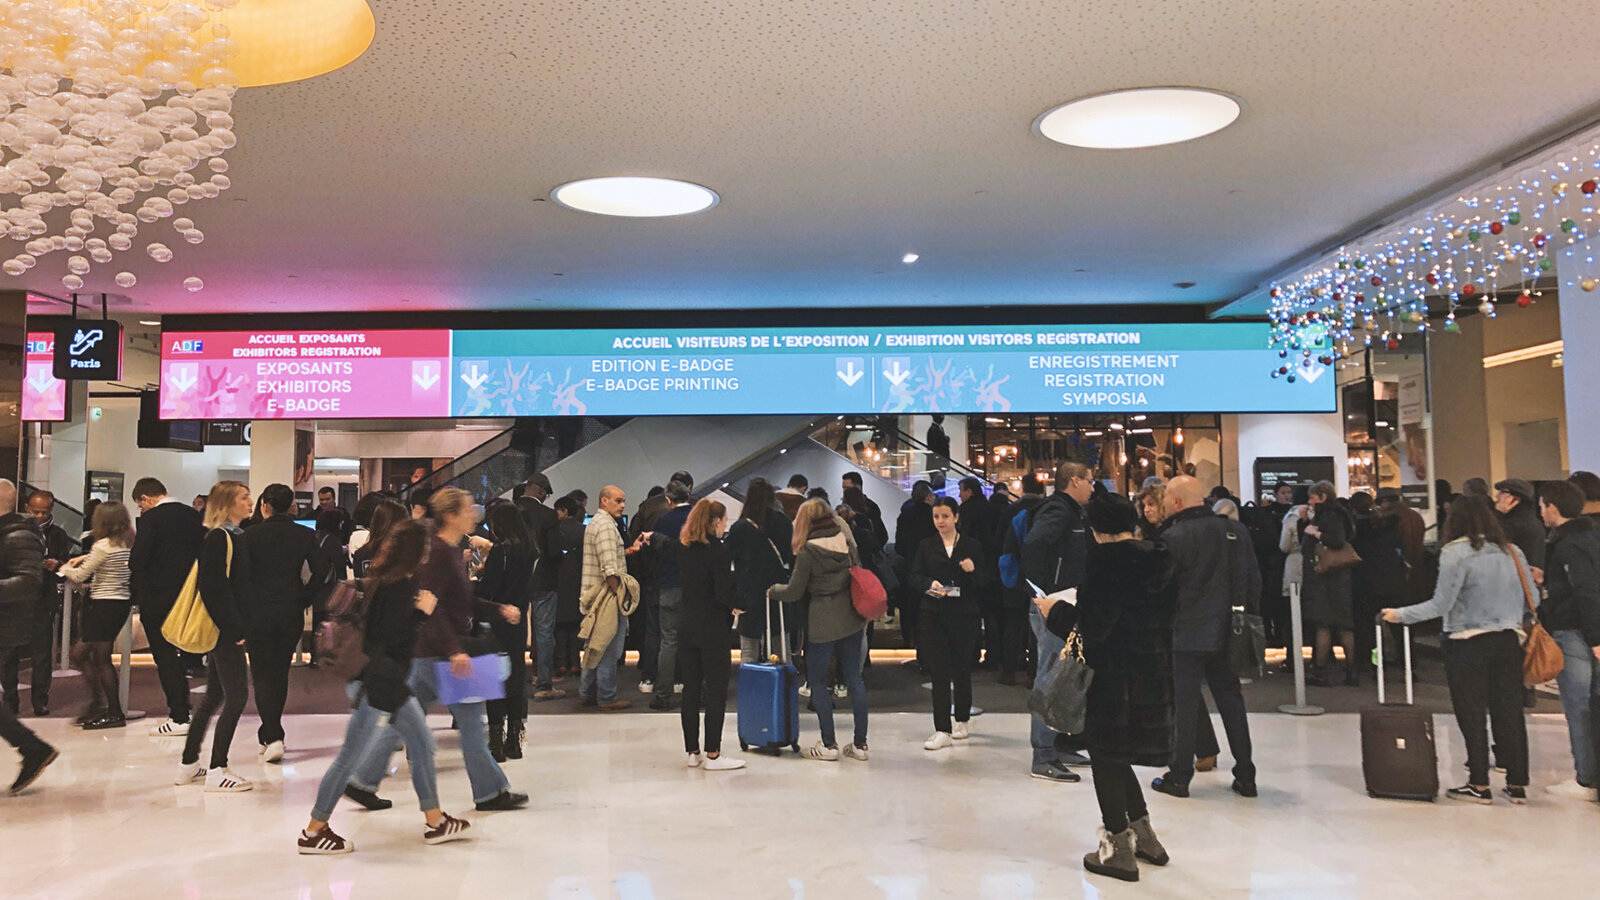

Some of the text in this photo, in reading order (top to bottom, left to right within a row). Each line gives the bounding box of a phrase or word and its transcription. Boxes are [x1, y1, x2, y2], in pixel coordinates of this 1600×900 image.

[249, 334, 365, 343] ACCUEIL EXPOSANTS
[613, 333, 1140, 348] ACCUEIL VISITEURS DE L'EXPOSITION / EXHIBITION VISITORS REGISTRATION
[172, 340, 202, 353] ADF
[233, 347, 381, 357] EXHIBITORS REGISTRATION
[71, 359, 100, 368] Paris
[592, 359, 733, 372] EDITION E-BADGE
[1030, 355, 1178, 368] ENREGISTREMENT
[257, 362, 352, 375] EXPOSANTS
[257, 380, 351, 393] EXHIBITORS
[586, 378, 738, 391] E-BADGE PRINTING
[1045, 374, 1164, 386] REGISTRATION
[268, 398, 340, 411] E-BADGE
[1063, 392, 1147, 405] SYMPOSIA
